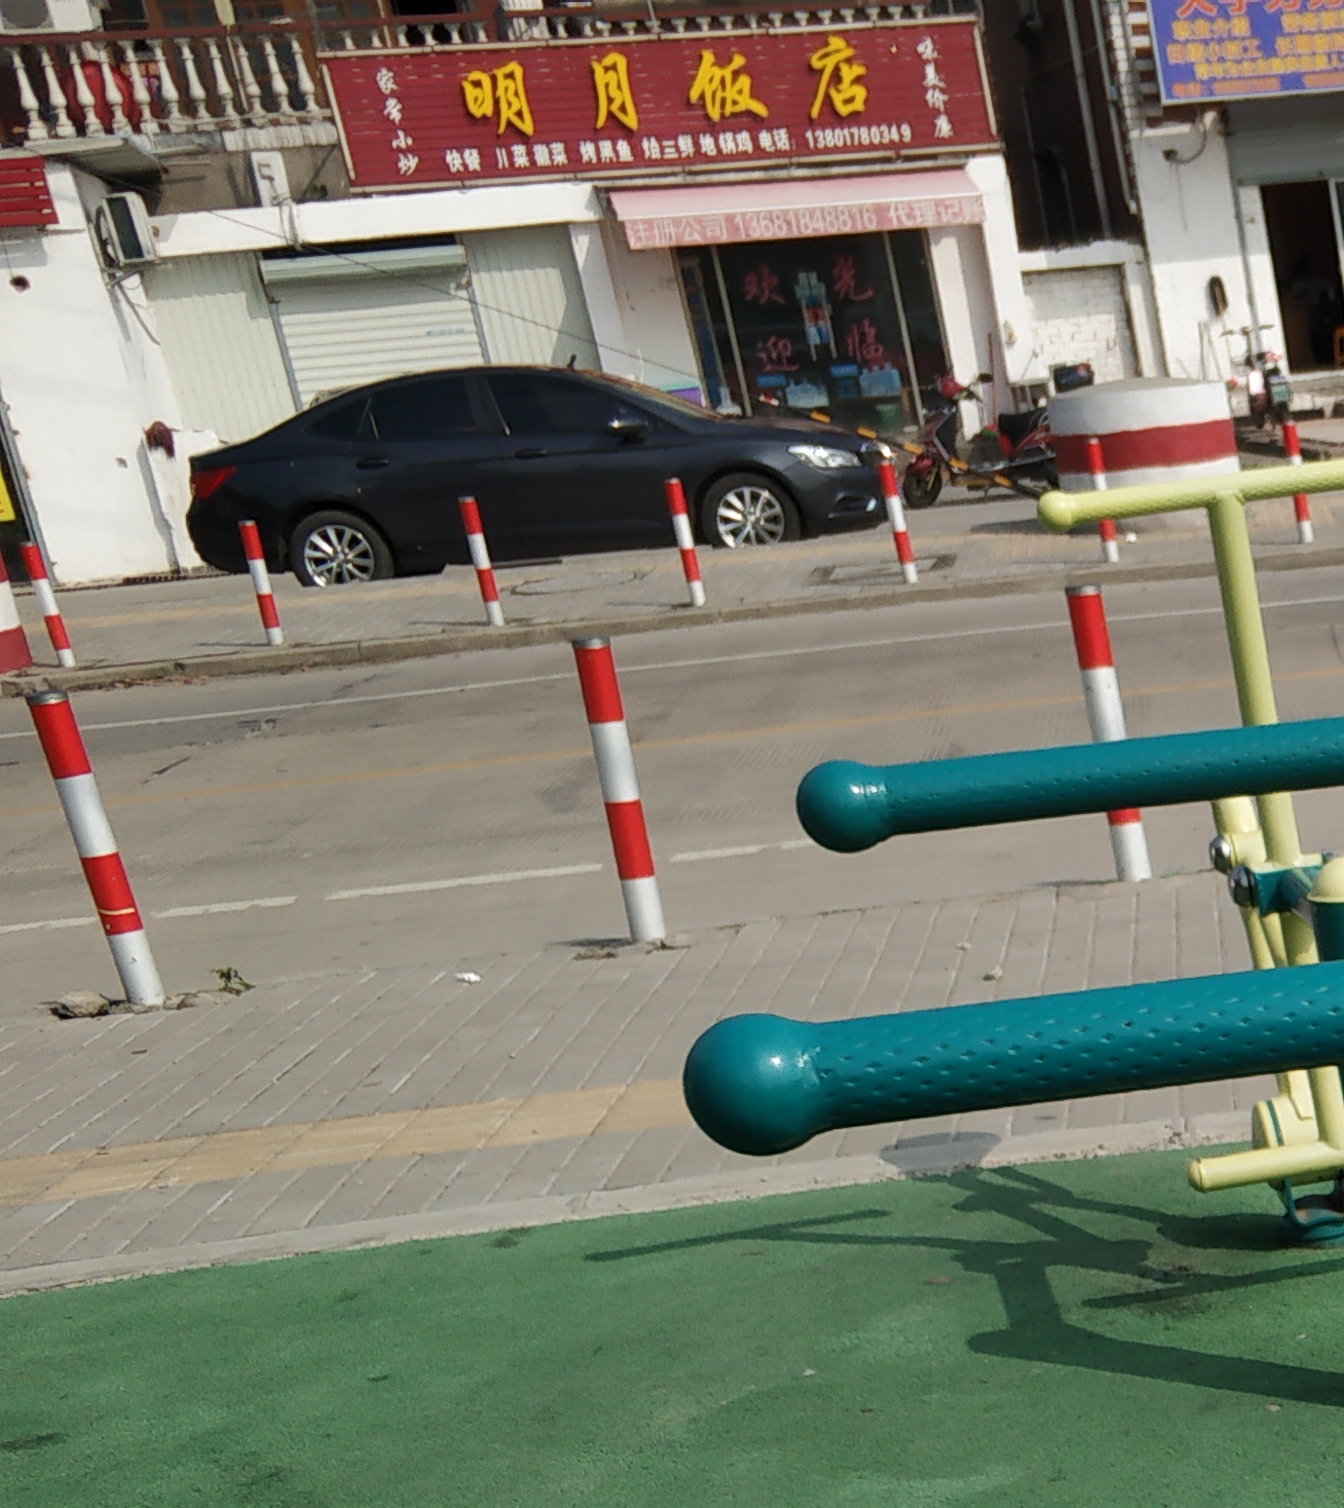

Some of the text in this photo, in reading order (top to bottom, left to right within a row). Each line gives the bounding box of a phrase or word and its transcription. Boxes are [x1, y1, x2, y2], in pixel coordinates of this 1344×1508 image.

[376, 66, 419, 176] 家常小炒
[461, 35, 868, 137] 明月饭店
[445, 147, 481, 173] 快餐
[805, 124, 911, 150] 13801780349
[629, 213, 728, 246] 注册公司
[734, 198, 877, 240] 13681848816
